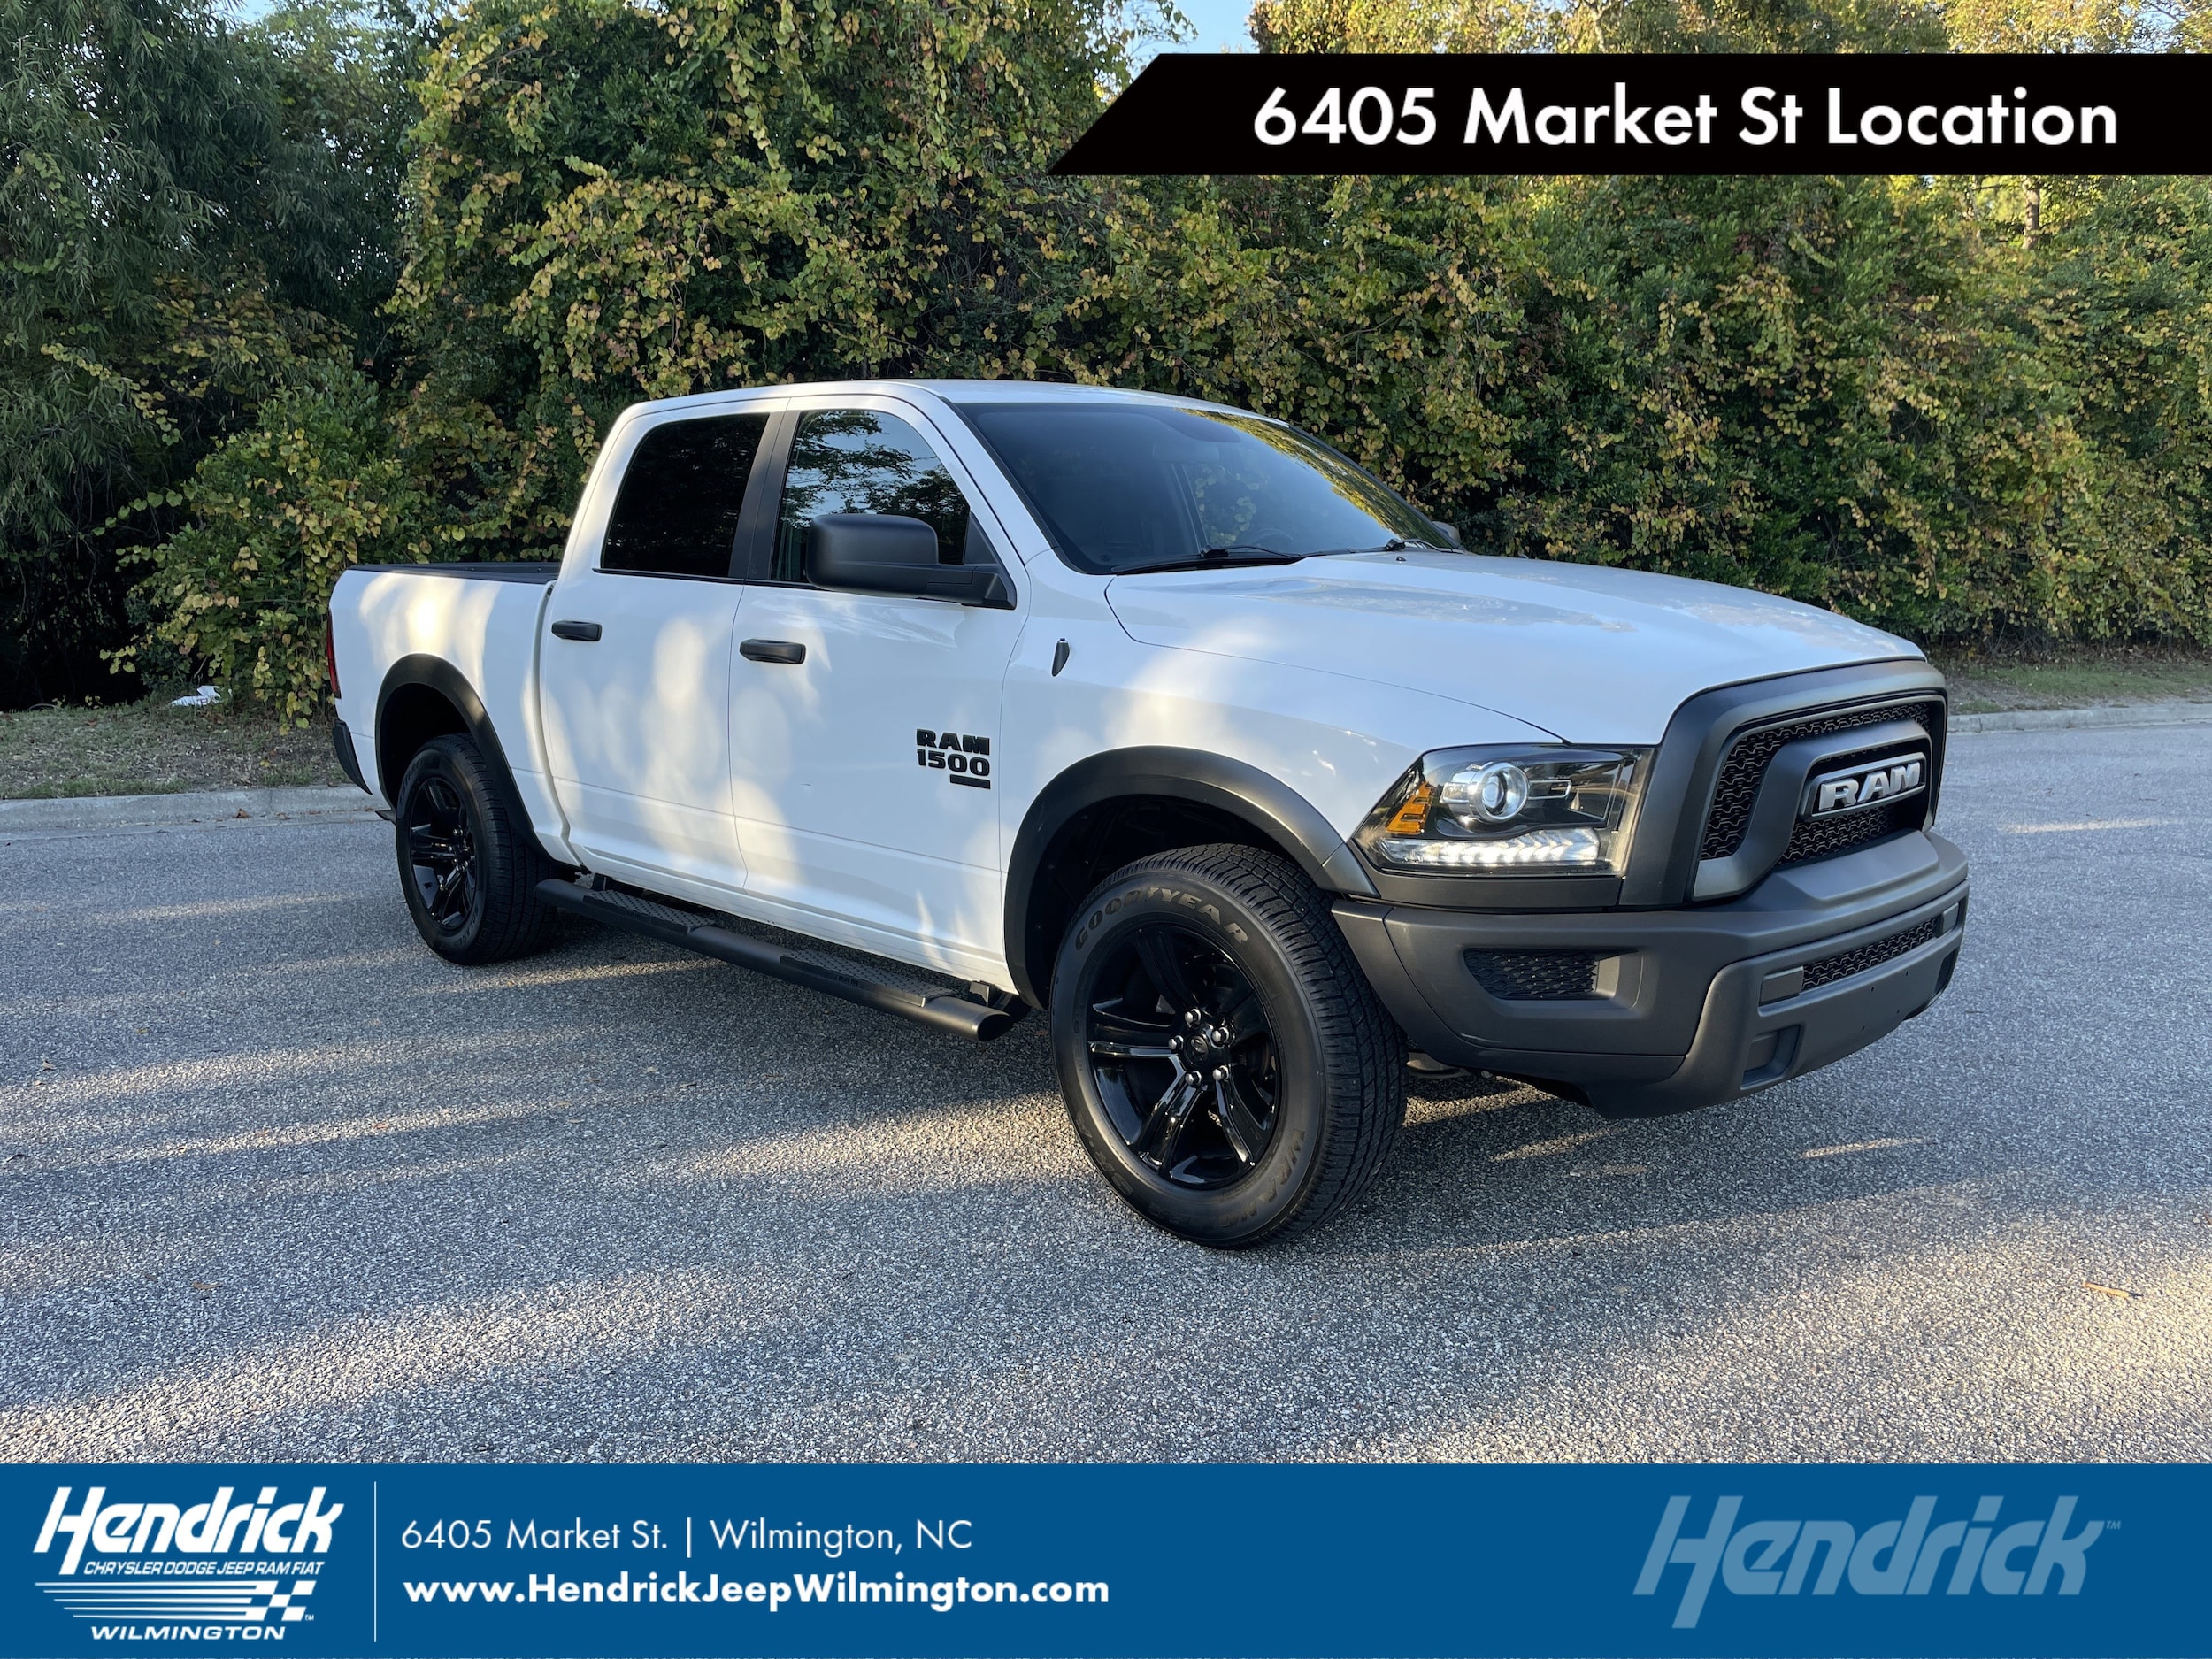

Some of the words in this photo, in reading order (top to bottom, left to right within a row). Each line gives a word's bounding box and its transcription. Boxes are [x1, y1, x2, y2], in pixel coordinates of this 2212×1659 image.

[917, 728, 990, 756] RAM
[917, 749, 990, 777] 1500
[1818, 762, 1921, 811] RAM
[1074, 886, 1249, 951] GOODYEAR
